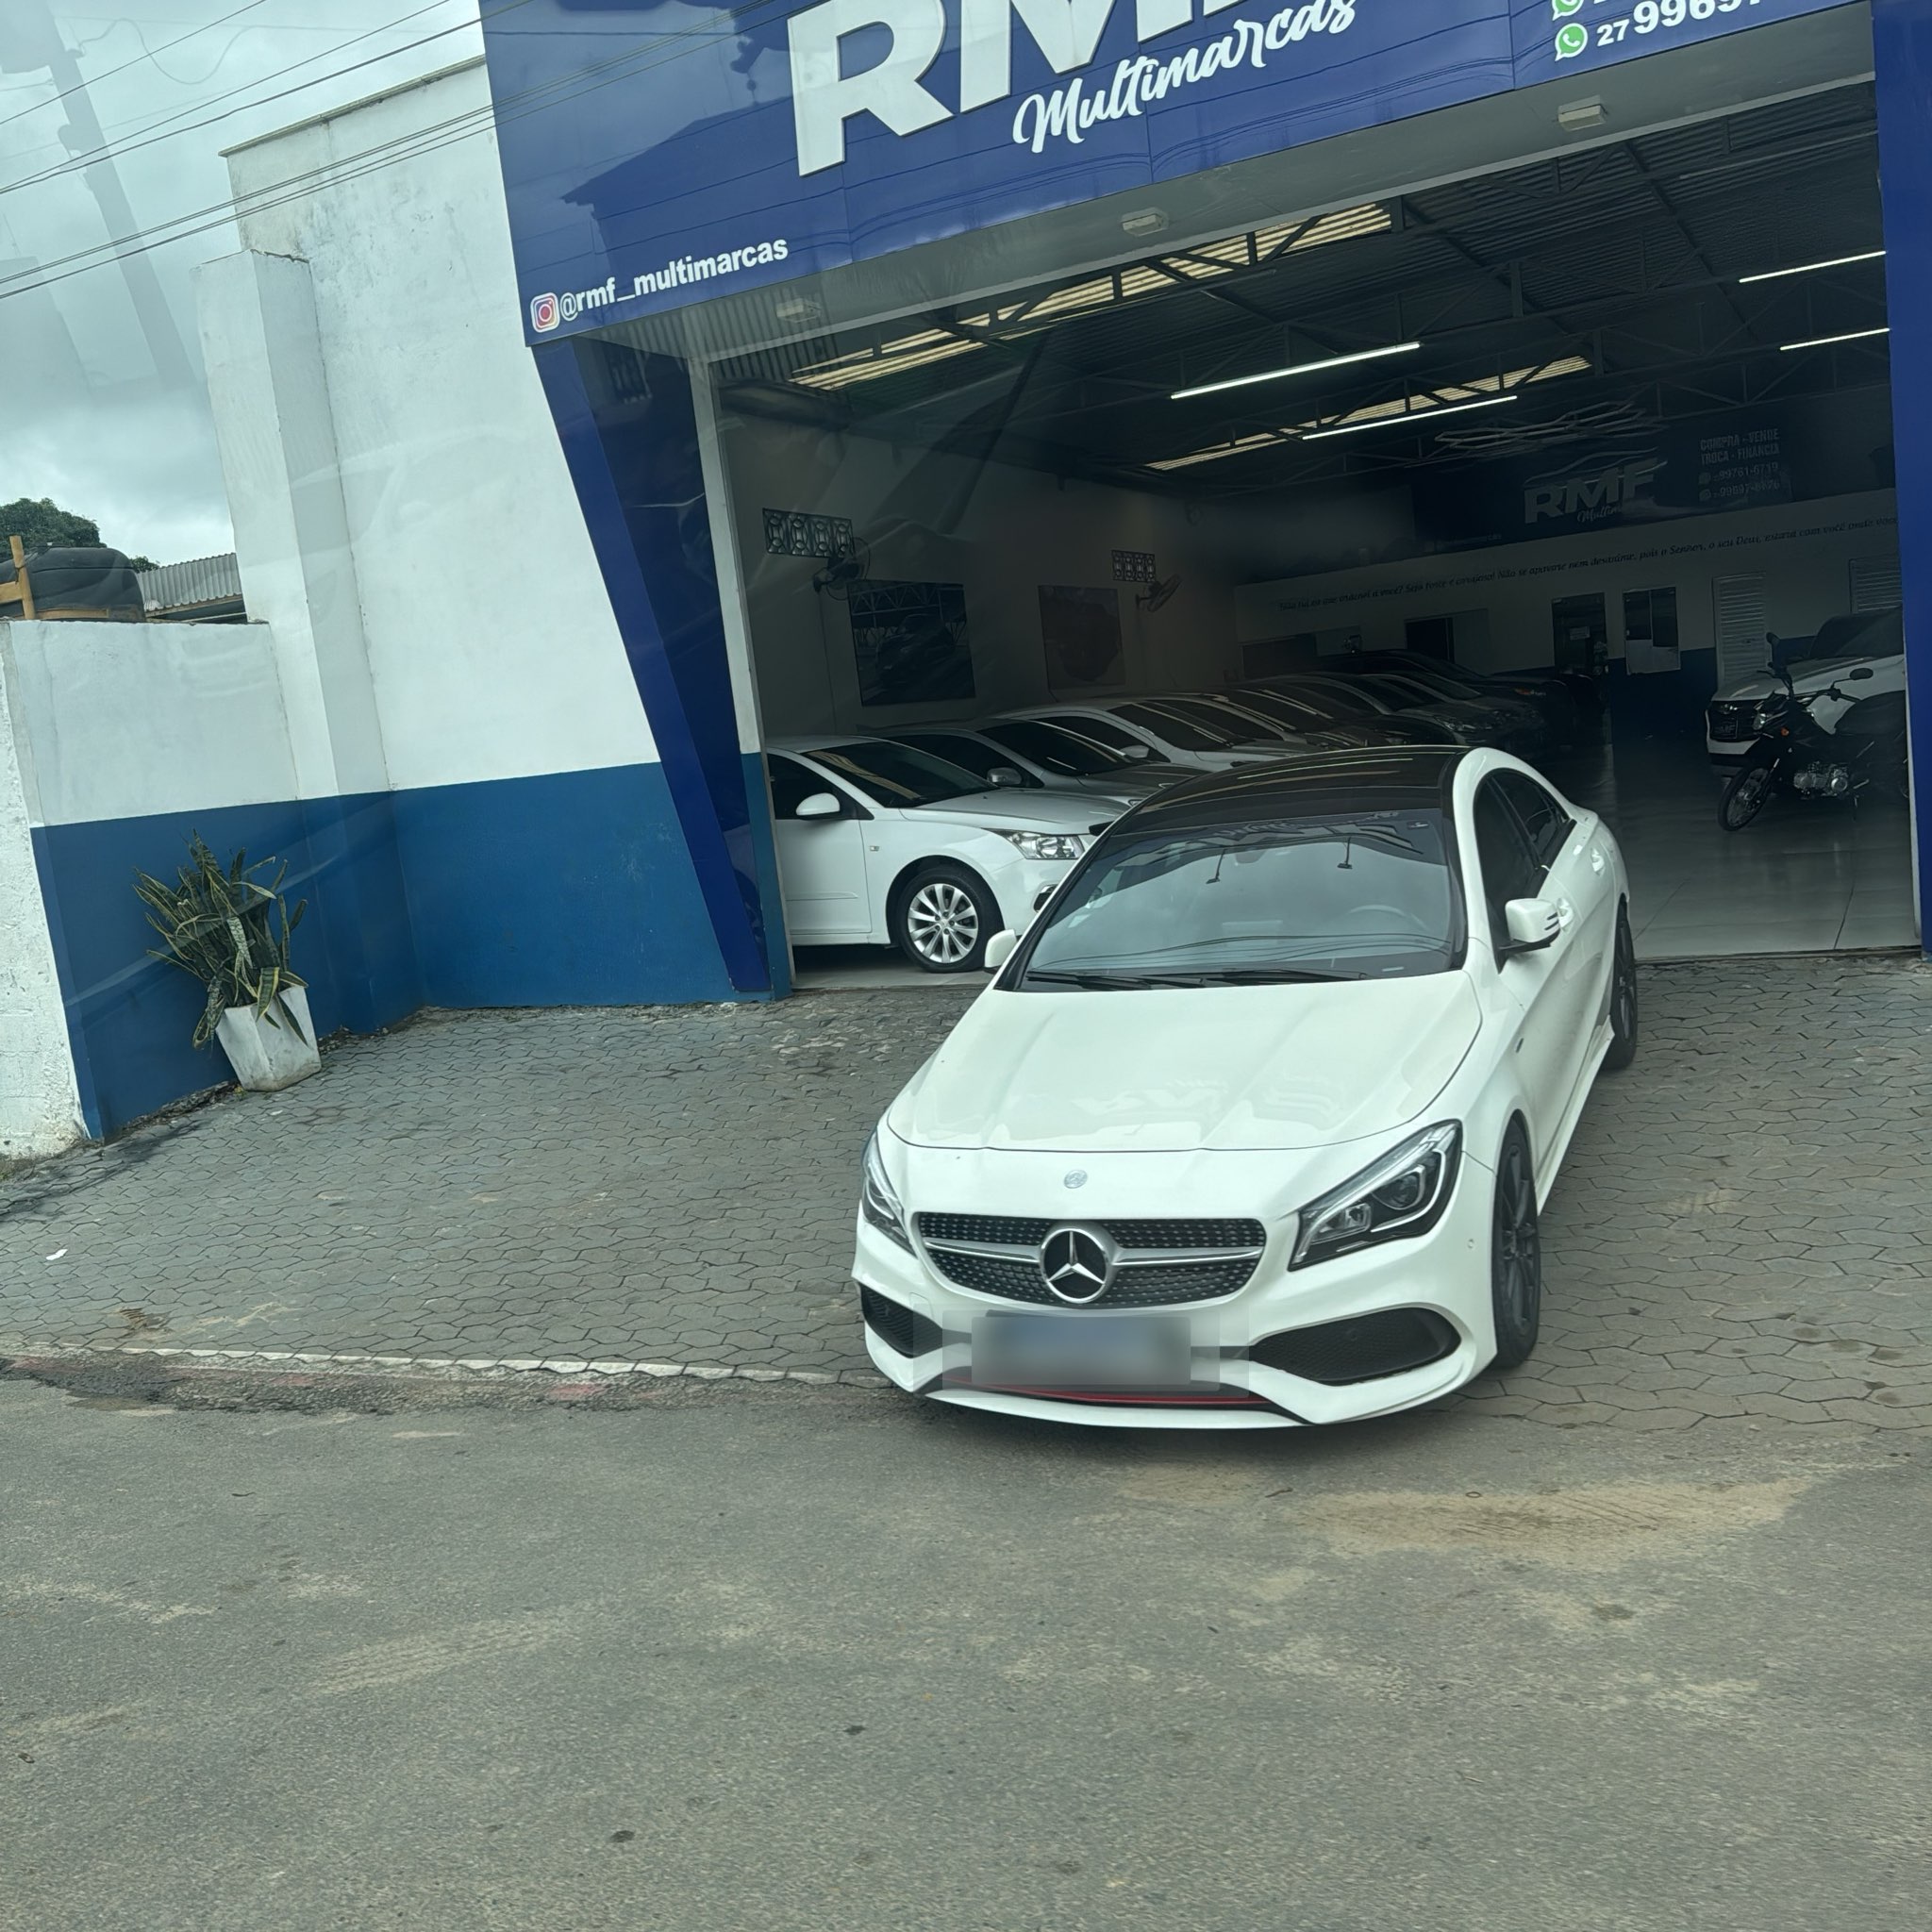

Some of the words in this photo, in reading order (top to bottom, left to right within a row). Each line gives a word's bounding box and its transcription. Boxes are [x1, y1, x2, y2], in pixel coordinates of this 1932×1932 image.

[1596, 19, 1630, 46] 27
[1633, 0, 1760, 34] 996
[788, 0, 1245, 176] RM
[1012, 0, 1356, 153] Multimarcas
[559, 239, 789, 321] @rmf_multimarcas
[1700, 434, 1740, 451] COMPRA
[1749, 428, 1780, 442] VENDE
[1701, 450, 1729, 465] TROCA
[1737, 442, 1780, 459] FINANCIA
[1524, 458, 1658, 525] RMF
